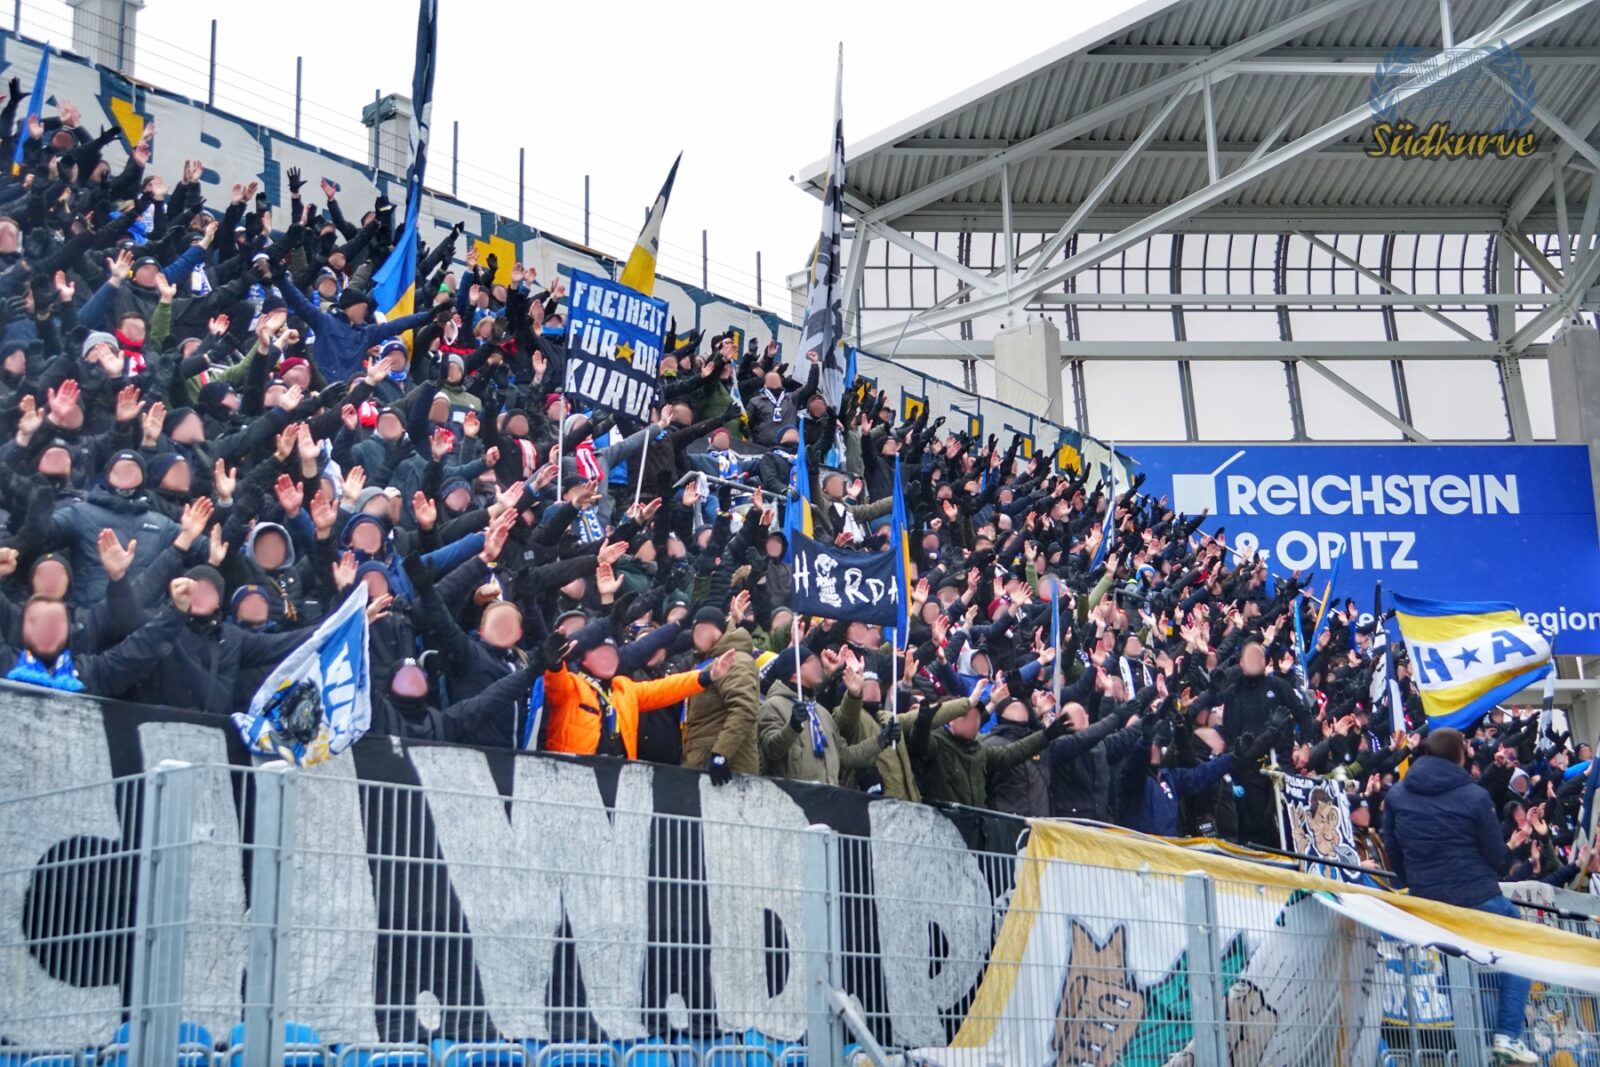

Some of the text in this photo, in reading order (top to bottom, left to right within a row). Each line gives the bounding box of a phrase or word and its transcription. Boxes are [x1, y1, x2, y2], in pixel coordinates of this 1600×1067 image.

[572, 280, 665, 336] FREIHEIT
[568, 318, 619, 362] FÜR
[1233, 531, 1419, 571] & OPITZ
[1514, 606, 1600, 637] egion
